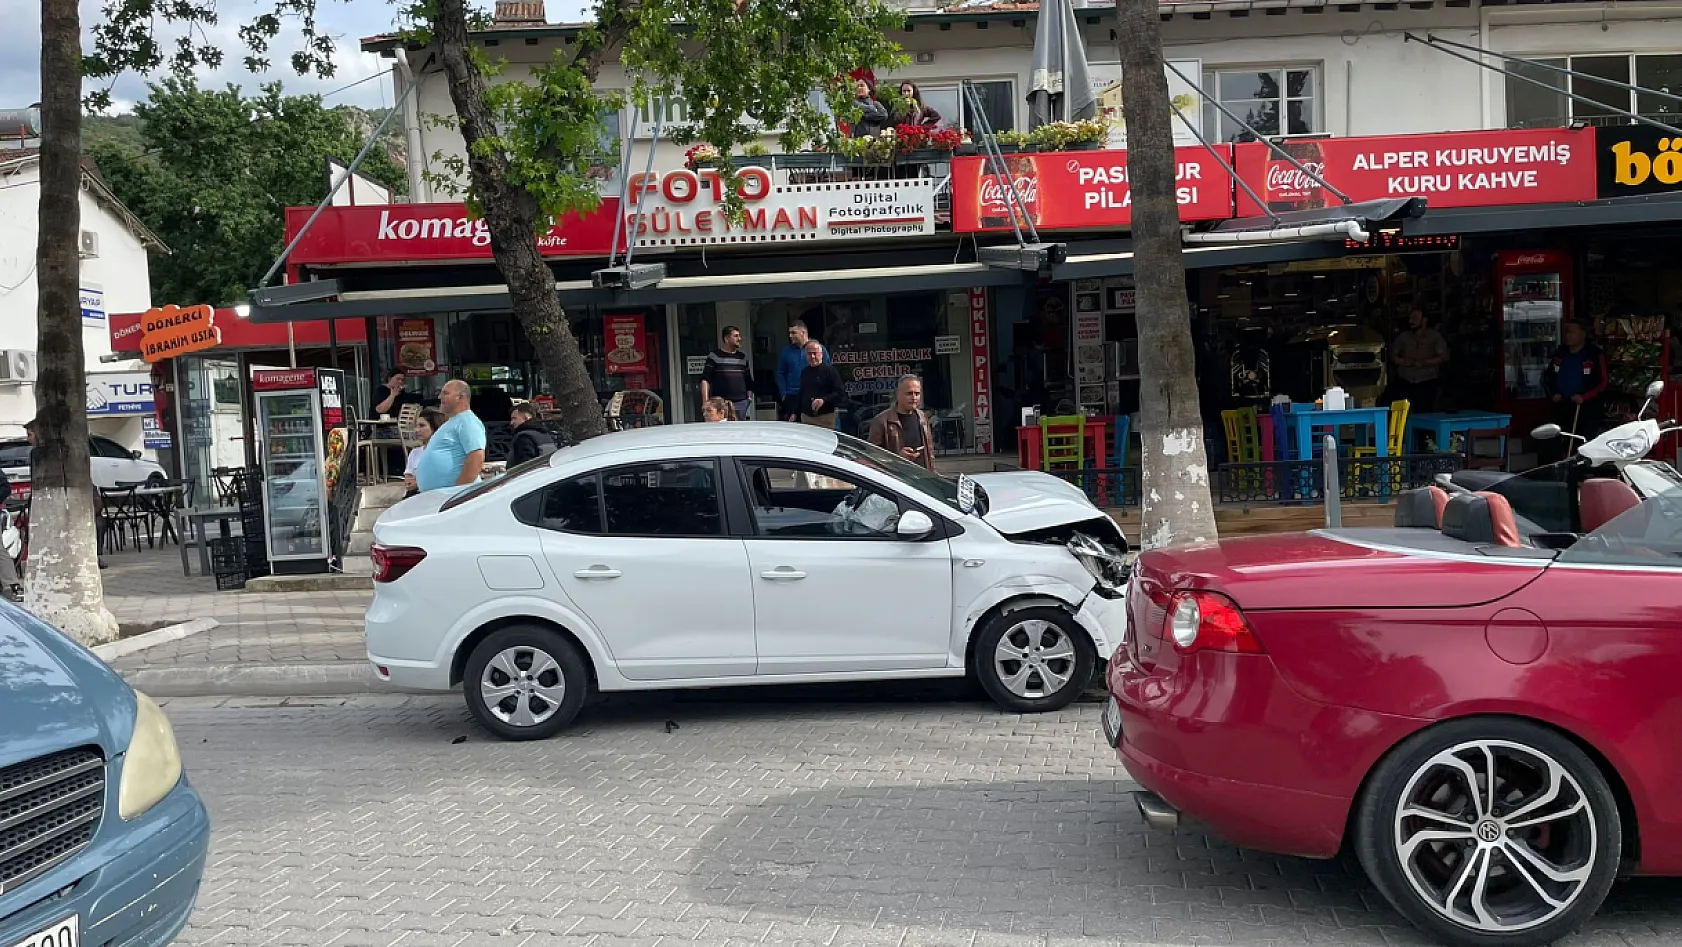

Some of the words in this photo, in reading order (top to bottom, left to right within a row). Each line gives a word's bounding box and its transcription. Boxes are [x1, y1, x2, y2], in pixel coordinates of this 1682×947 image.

[1352, 150, 1429, 171] ALPER
[1435, 141, 1571, 167] KURUYEMİŞ
[1612, 137, 1682, 186] bö
[628, 167, 771, 206] FOTO
[1387, 174, 1452, 194] KURU
[1458, 170, 1538, 191] KAHVE
[854, 192, 897, 204] Dijital
[829, 204, 924, 218] Fotoğrafçılık
[628, 206, 817, 236] SÜLEYMAN
[831, 226, 861, 236] Digital
[864, 224, 924, 234] Photography
[191, 329, 215, 344] USTA
[832, 351, 868, 363] ACELE
